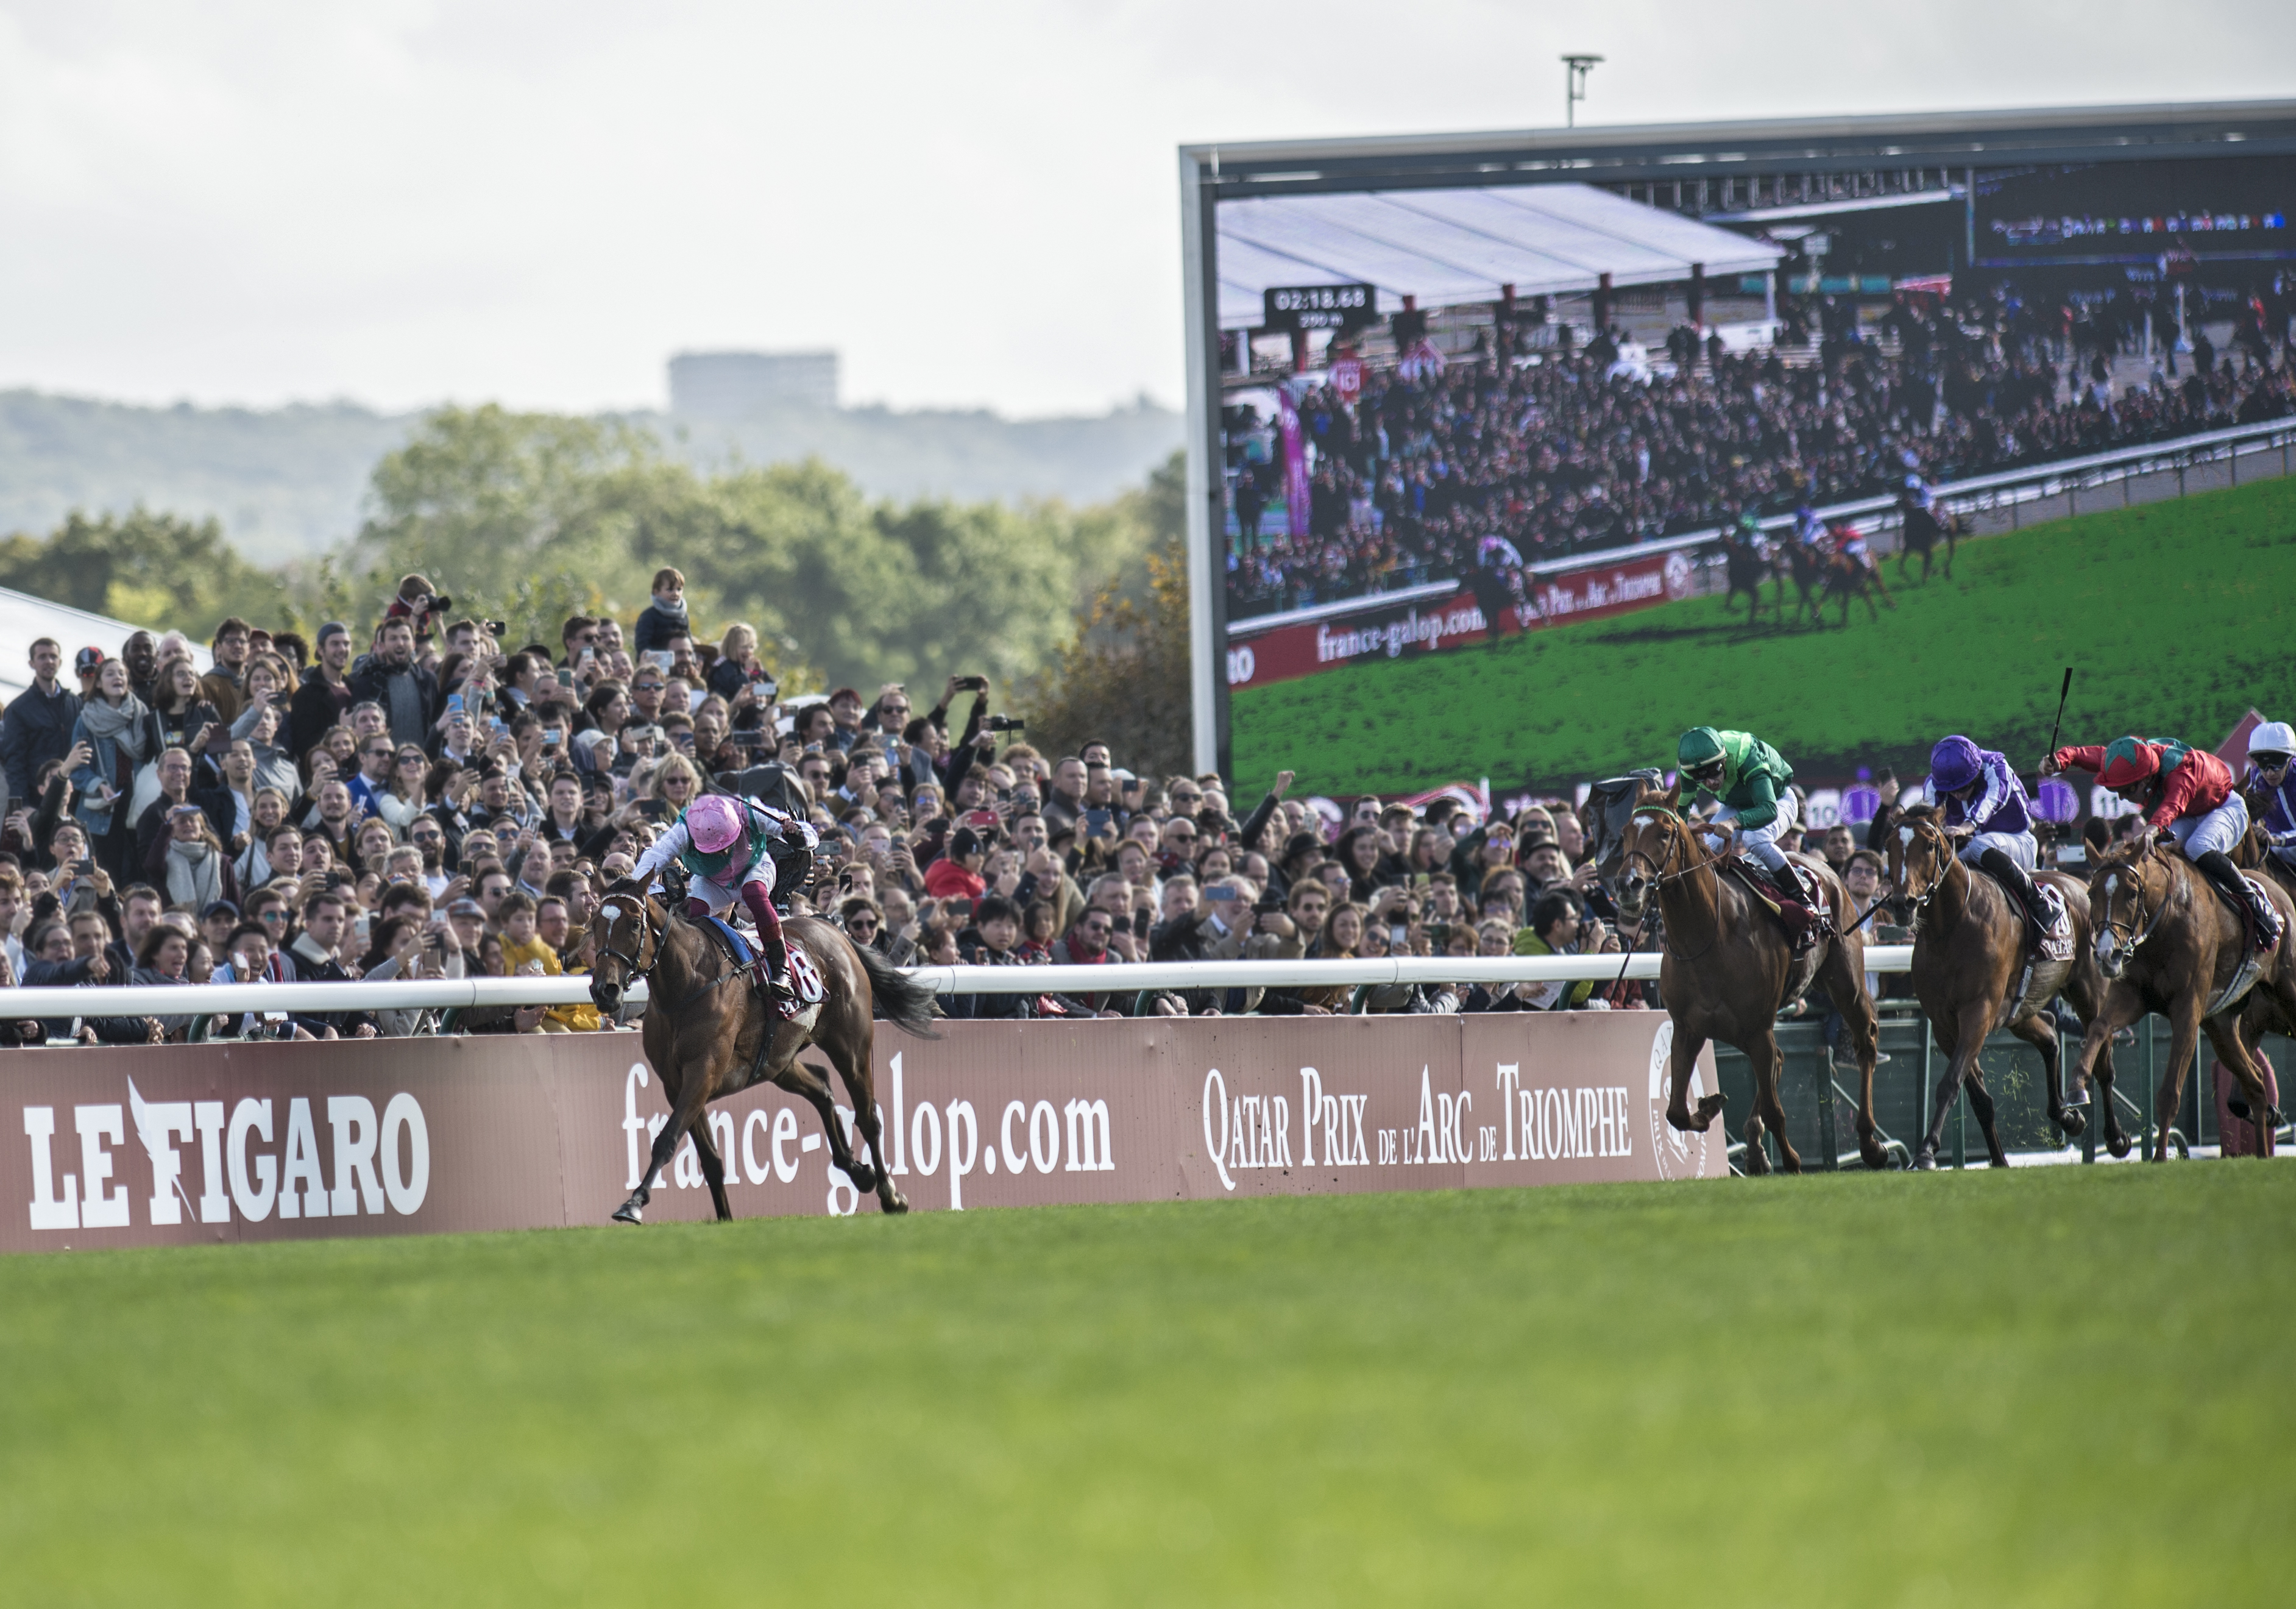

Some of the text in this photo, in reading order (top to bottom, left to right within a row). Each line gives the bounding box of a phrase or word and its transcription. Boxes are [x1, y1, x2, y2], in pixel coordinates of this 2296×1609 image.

[1812, 805, 1838, 822] 10
[2100, 796, 2117, 814] 11
[1203, 1061, 1632, 1191] QATAR PRIX DE L'ARC DE TRIOMPHE
[1653, 1109, 1665, 1157] PRIX
[23, 1075, 430, 1230] LE FIGARO
